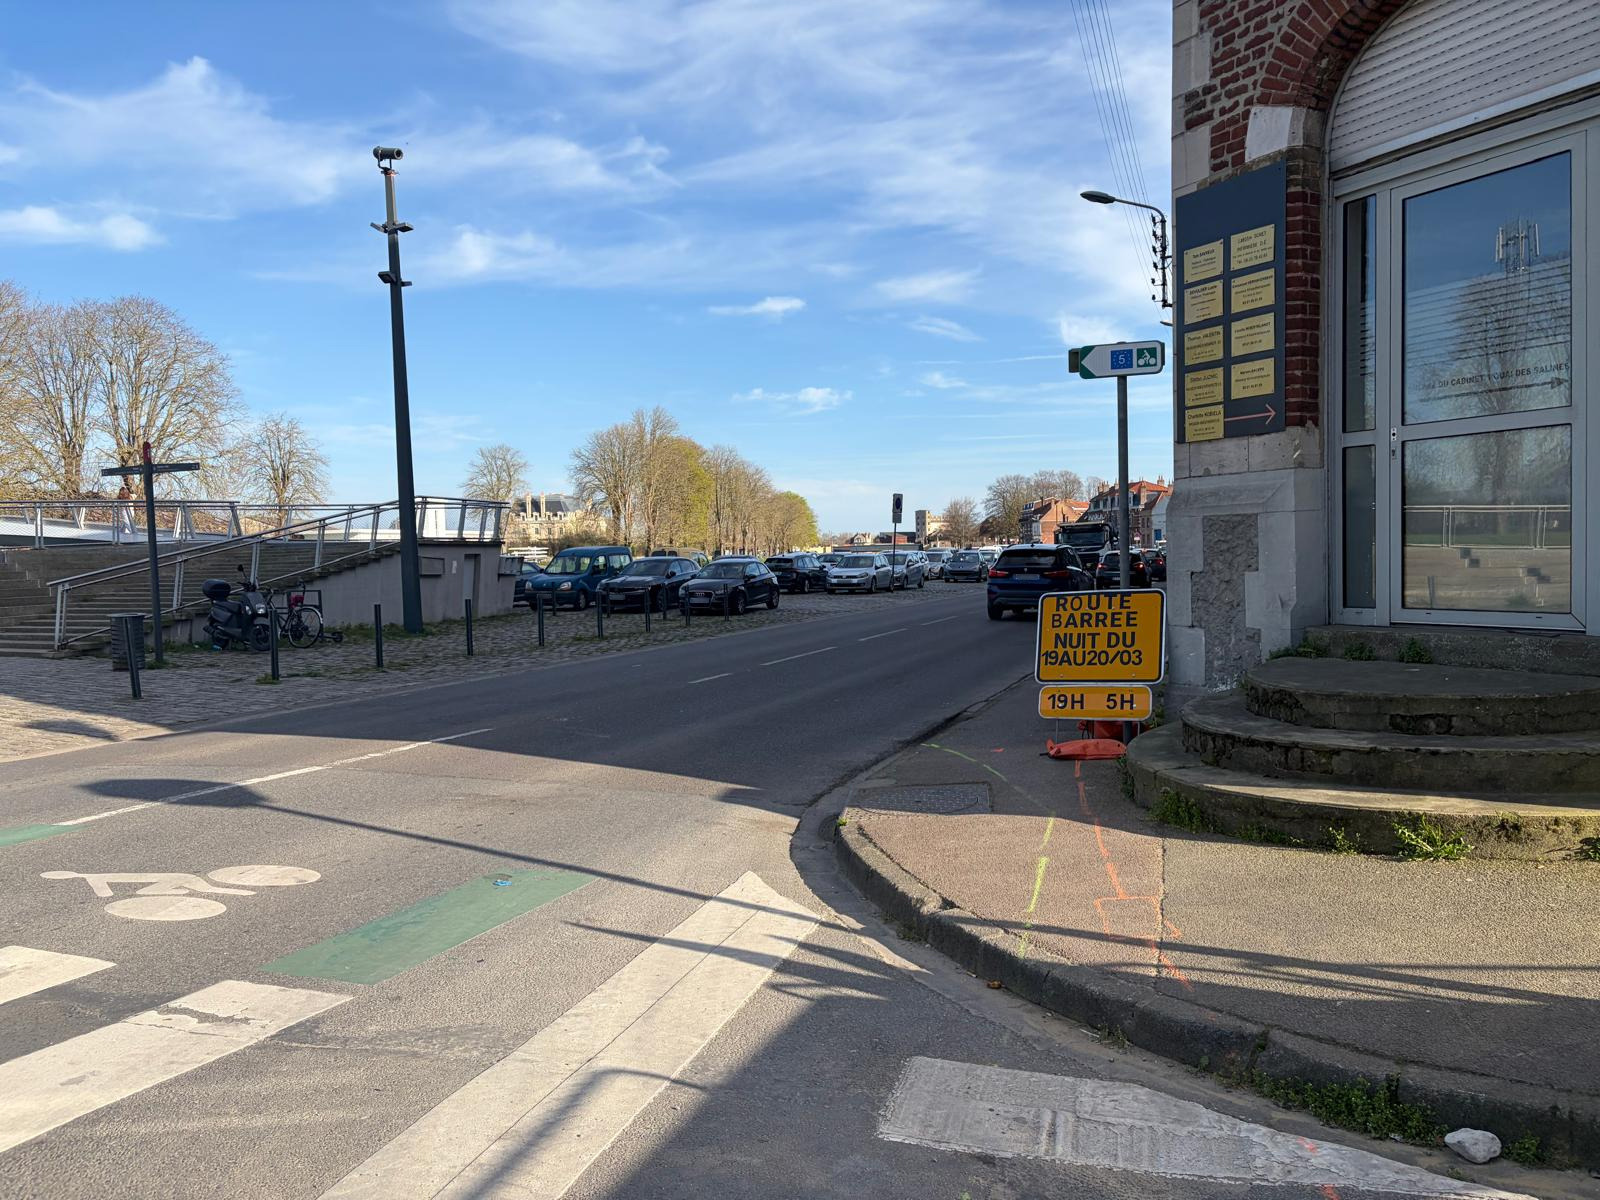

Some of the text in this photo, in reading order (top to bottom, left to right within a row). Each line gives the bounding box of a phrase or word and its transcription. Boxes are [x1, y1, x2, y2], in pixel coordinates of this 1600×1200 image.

[1119, 354, 1125, 364] 5
[1438, 378, 1449, 388] DU
[1450, 374, 1484, 386] CABINET
[1493, 370, 1513, 380] QUAI
[1515, 367, 1532, 377] DES
[1534, 362, 1570, 375] SALINES
[1055, 593, 1132, 612] ROUTE
[1051, 611, 1138, 629] BARREE
[1054, 631, 1136, 649] NUIT DU
[1041, 649, 1143, 666] 19AU20/03
[1047, 693, 1135, 710] 19H 5H
